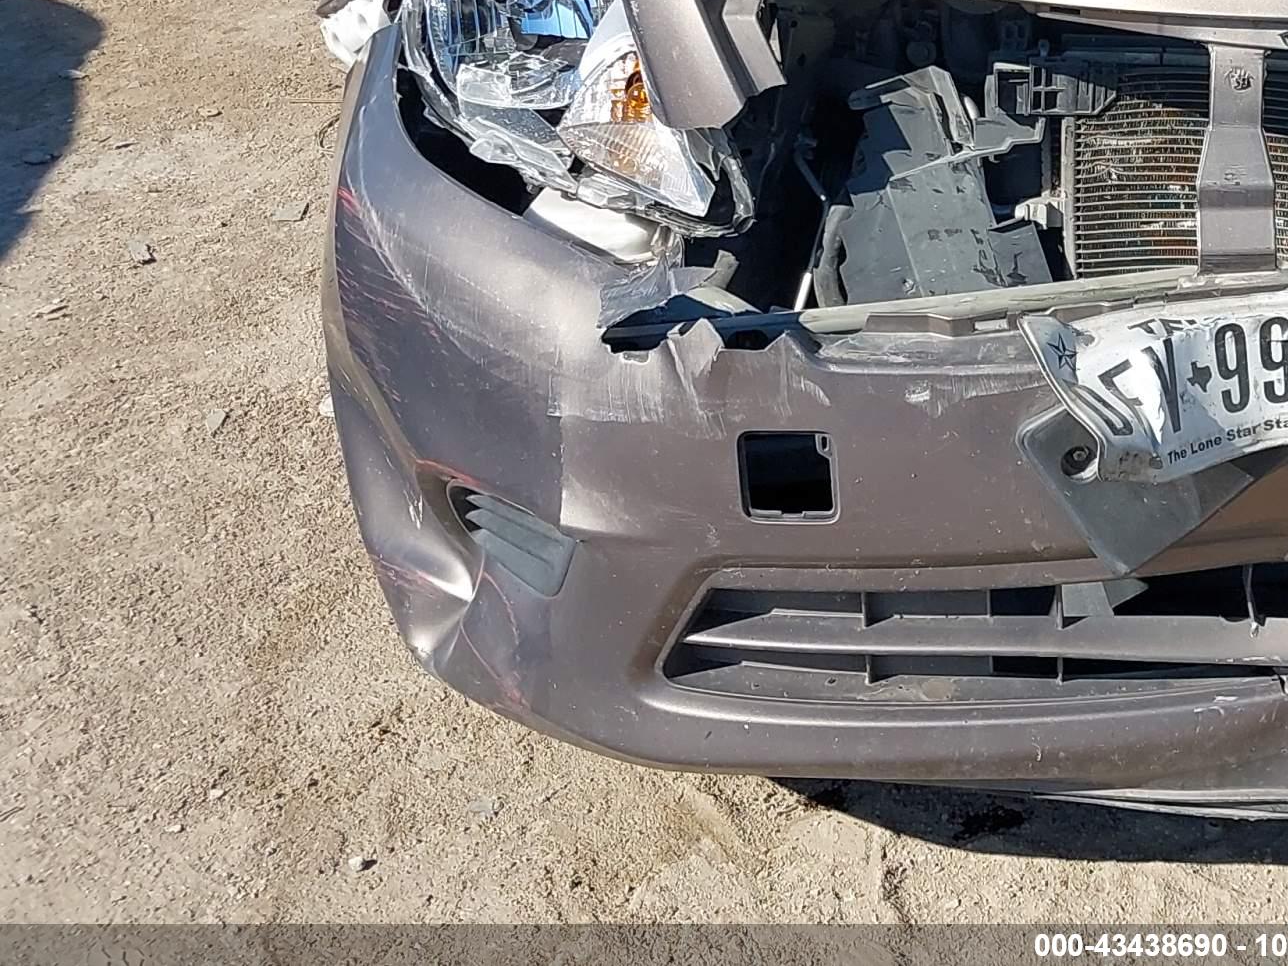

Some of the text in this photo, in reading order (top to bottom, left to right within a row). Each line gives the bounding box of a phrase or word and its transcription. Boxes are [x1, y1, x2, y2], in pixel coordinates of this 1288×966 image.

[1167, 446, 1187, 465] The
[1190, 434, 1222, 455] Lone
[1226, 423, 1260, 441] Star
